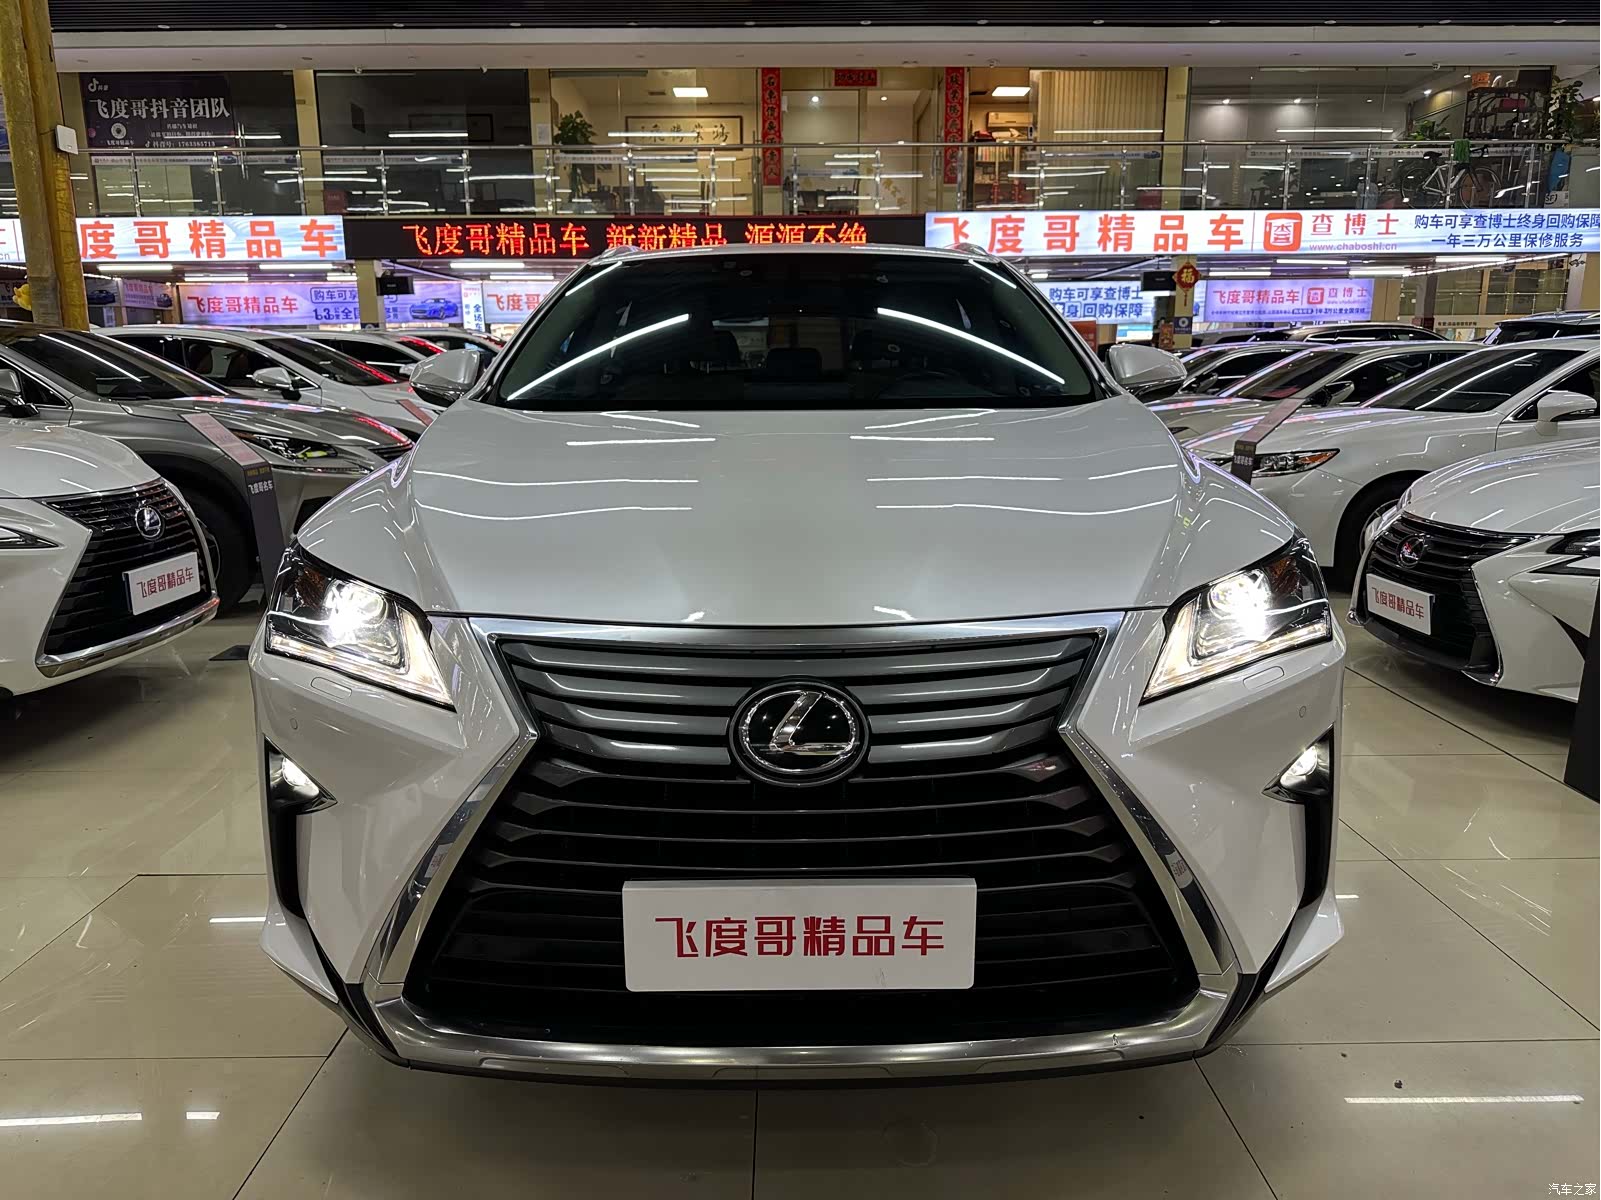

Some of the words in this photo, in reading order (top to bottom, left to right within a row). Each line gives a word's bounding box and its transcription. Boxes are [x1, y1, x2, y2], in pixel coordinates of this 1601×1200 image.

[89, 97, 231, 119] 飞度哥抖音团队
[1310, 212, 1399, 236] 查博士
[1413, 213, 1600, 230] 购车可享查博士终身回购保障
[402, 222, 590, 257] 飞度哥精品车
[605, 222, 728, 250] 新新精品
[743, 222, 869, 245] 源源不绝
[934, 213, 1244, 253] 飞度哥精品车
[1431, 232, 1584, 249] 一年三万公里保修服务
[1309, 241, 1398, 251] www.chaboshi.cn
[1180, 268, 1195, 283] 福
[486, 293, 549, 312] 飞度哥
[1048, 286, 1144, 302] 购车可享查博士
[1212, 288, 1300, 305] 飞度哥精品车
[1327, 287, 1368, 298] 查博士
[187, 295, 299, 314] 飞度哥精品车
[136, 566, 194, 598] 飞度哥精品车
[1371, 586, 1425, 620] 飞度哥精品车
[655, 915, 945, 958] 飞度哥精品车
